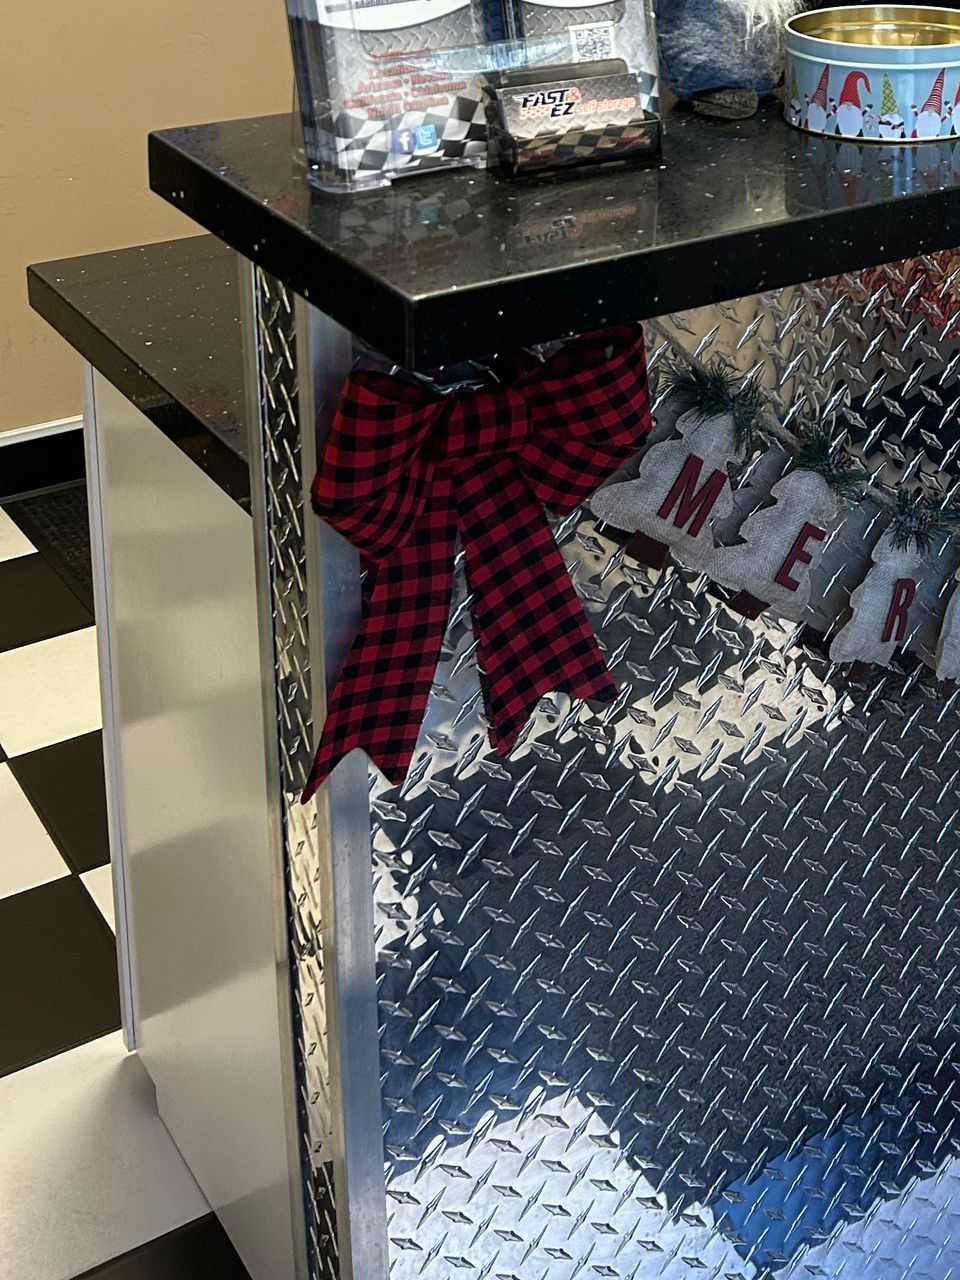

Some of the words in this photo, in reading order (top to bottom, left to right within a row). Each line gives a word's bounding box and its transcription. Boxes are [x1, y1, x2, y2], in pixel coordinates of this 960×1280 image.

[514, 88, 569, 108] FAST
[597, 97, 637, 112] storage
[550, 102, 576, 118] EZ
